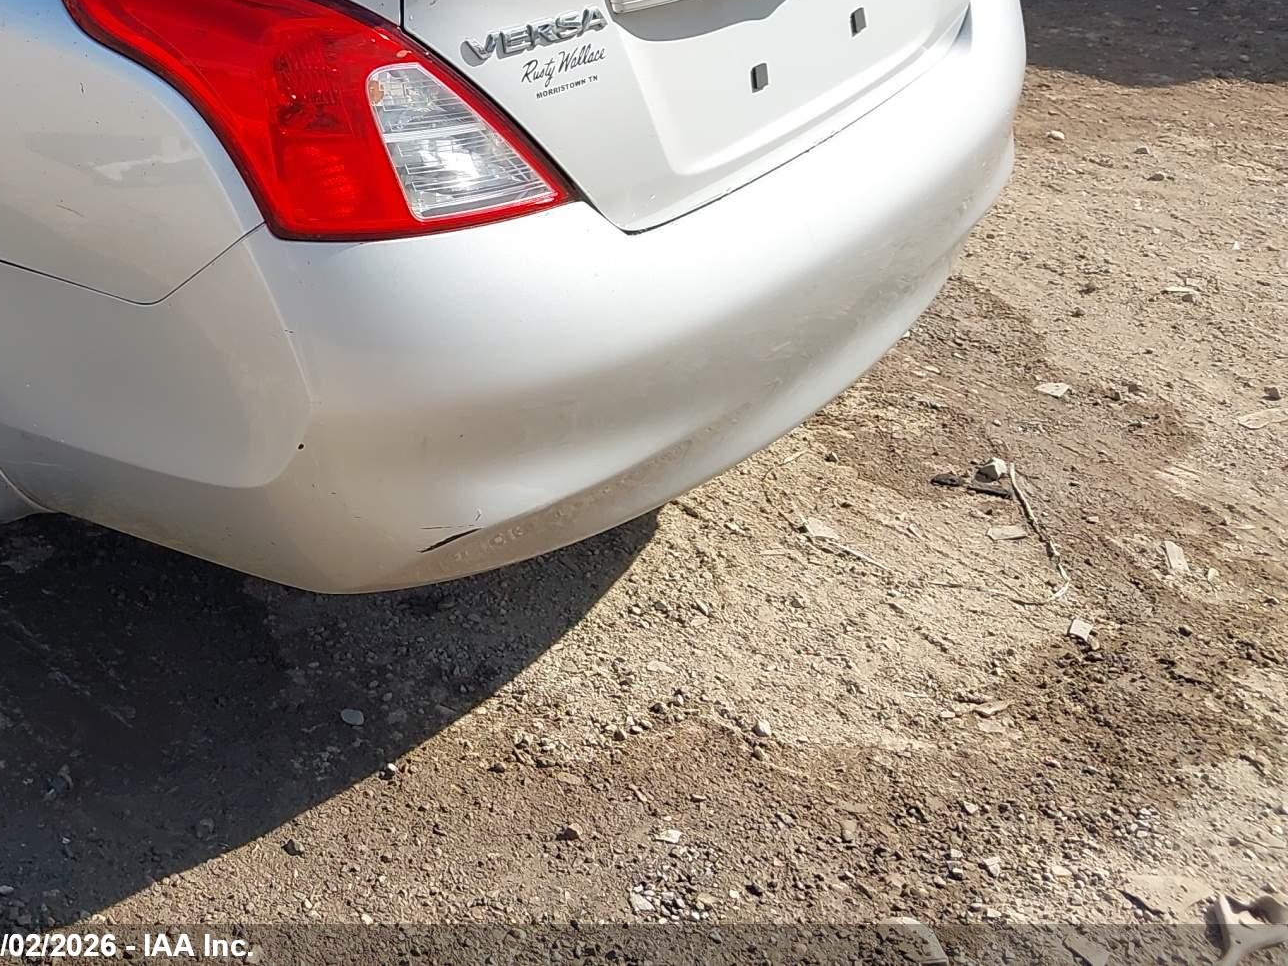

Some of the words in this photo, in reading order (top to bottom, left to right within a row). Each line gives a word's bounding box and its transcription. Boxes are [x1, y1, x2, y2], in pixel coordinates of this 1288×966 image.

[460, 6, 609, 67] VERSA
[521, 59, 556, 87] Rusty
[558, 43, 607, 75] Wallace
[536, 78, 587, 99] MORRISTOWN
[588, 74, 599, 83] TN
